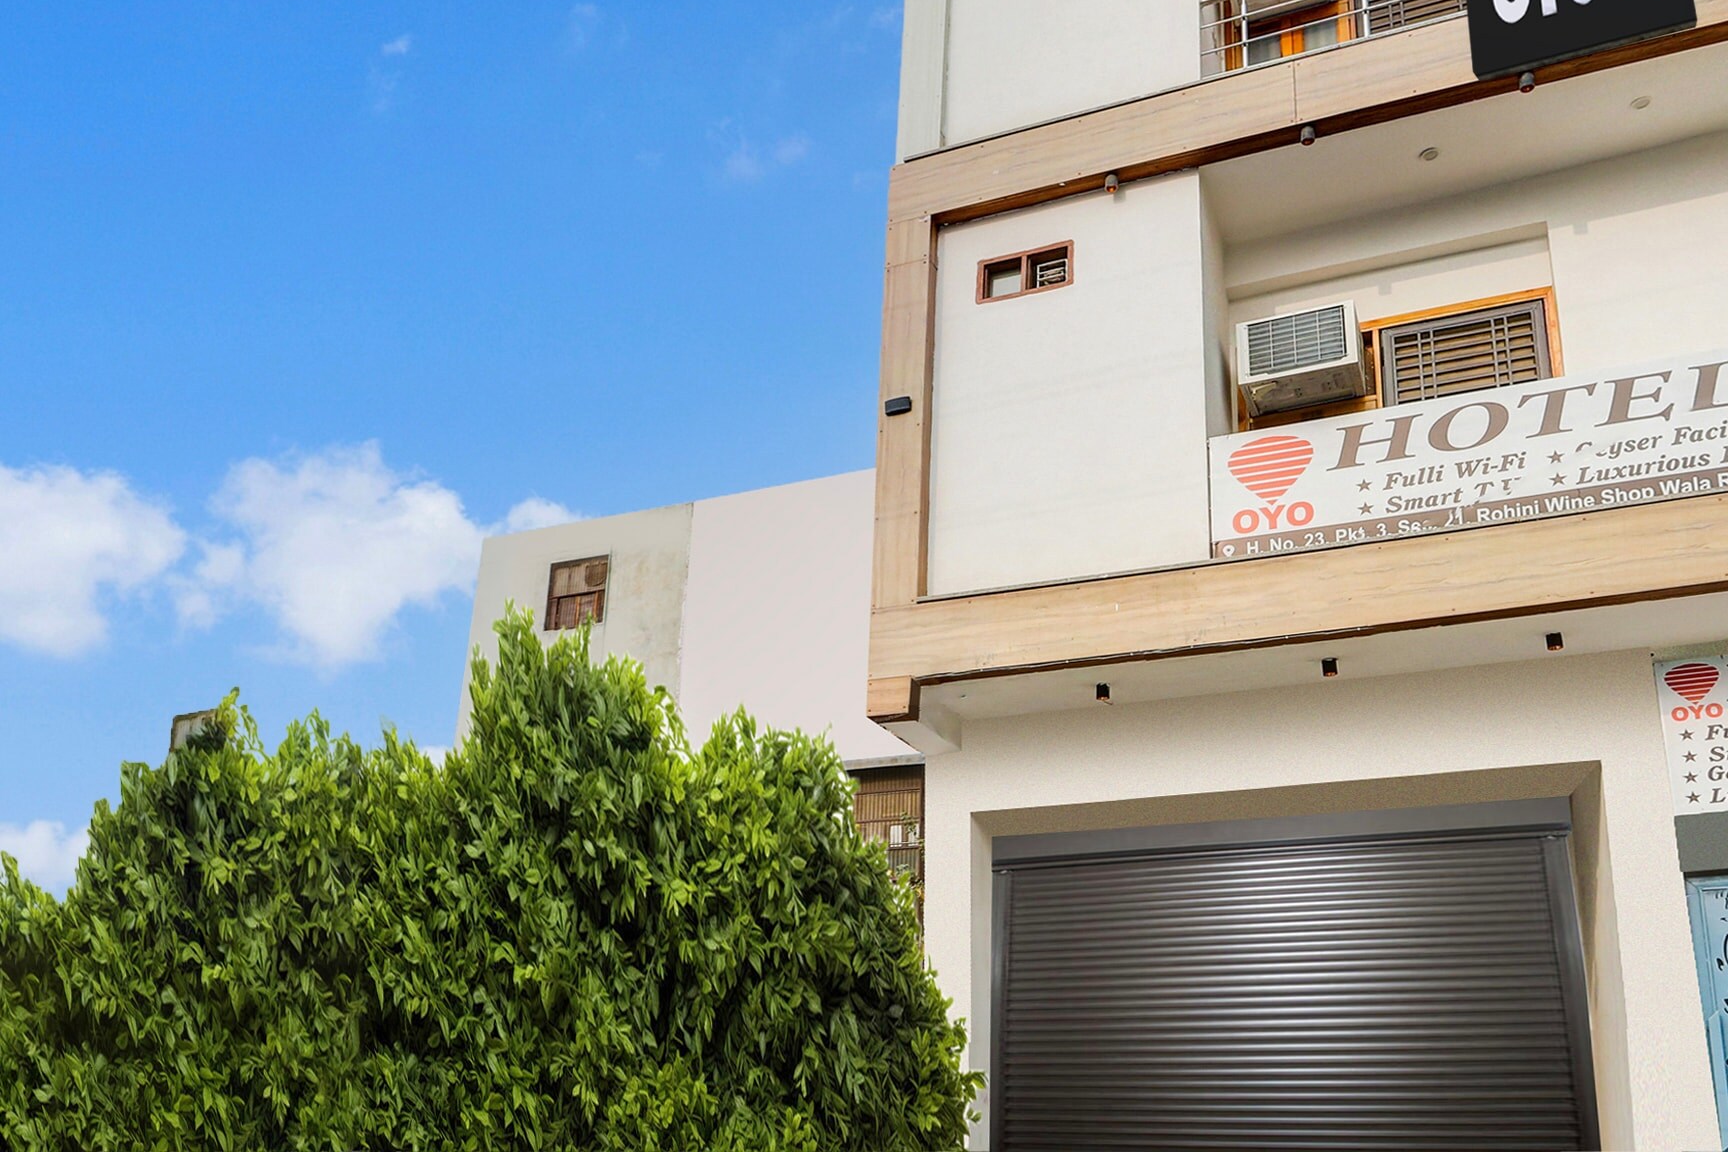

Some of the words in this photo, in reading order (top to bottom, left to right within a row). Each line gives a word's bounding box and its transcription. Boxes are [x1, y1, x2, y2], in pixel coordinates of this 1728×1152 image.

[1382, 465, 1445, 492] Fulli
[1454, 451, 1527, 480] Wi-Fi
[1576, 451, 1711, 486] Luxurious
[1385, 487, 1463, 515] Smart
[1477, 501, 1541, 524] Rohini
[1545, 490, 1596, 513] Wine
[1602, 485, 1654, 506] Shop
[1659, 475, 1712, 497] Wala
[1232, 501, 1315, 535] OYO
[1671, 702, 1724, 722] OYO
